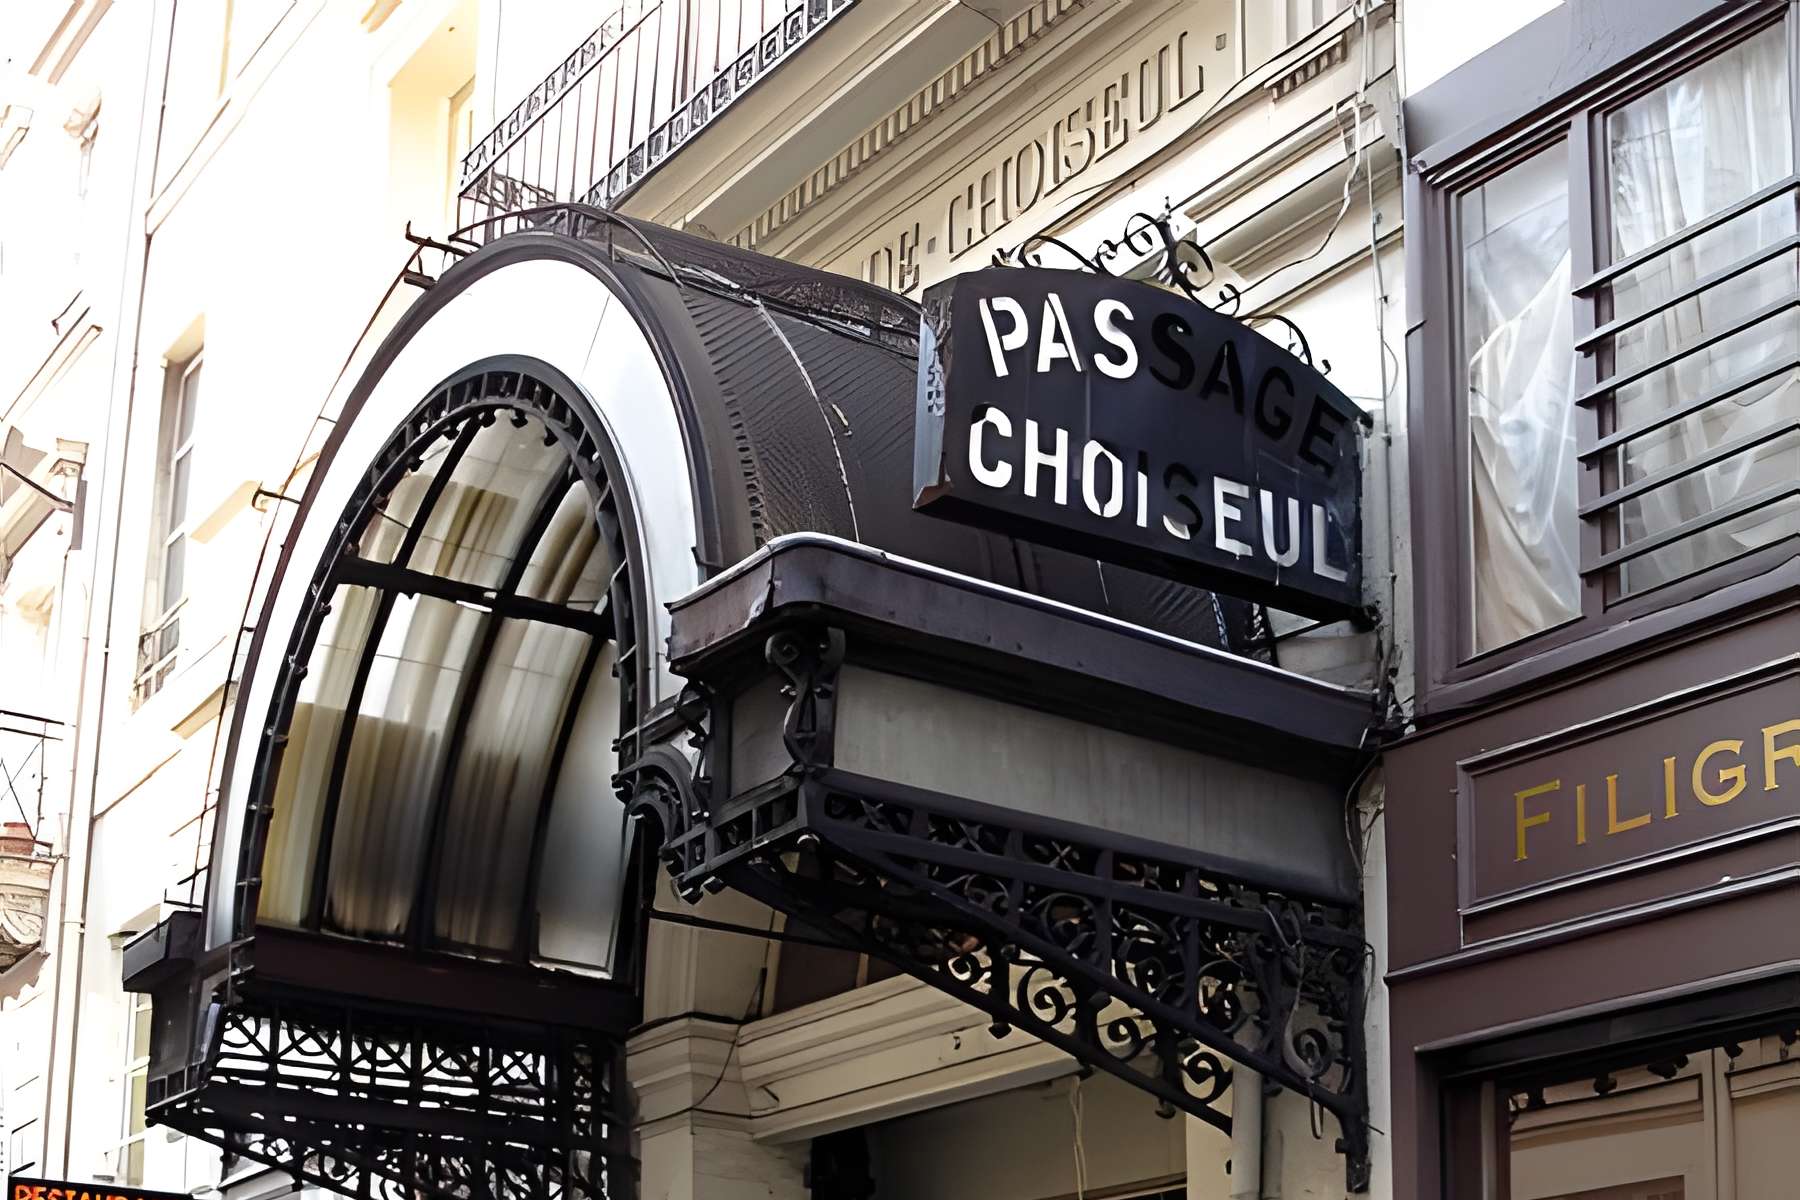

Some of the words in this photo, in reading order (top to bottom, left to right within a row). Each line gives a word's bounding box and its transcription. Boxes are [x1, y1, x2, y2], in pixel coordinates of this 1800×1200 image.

[948, 31, 1204, 262] CHOISEUL
[979, 293, 1348, 478] PASSAGE
[968, 402, 1348, 583] CHOISEUL
